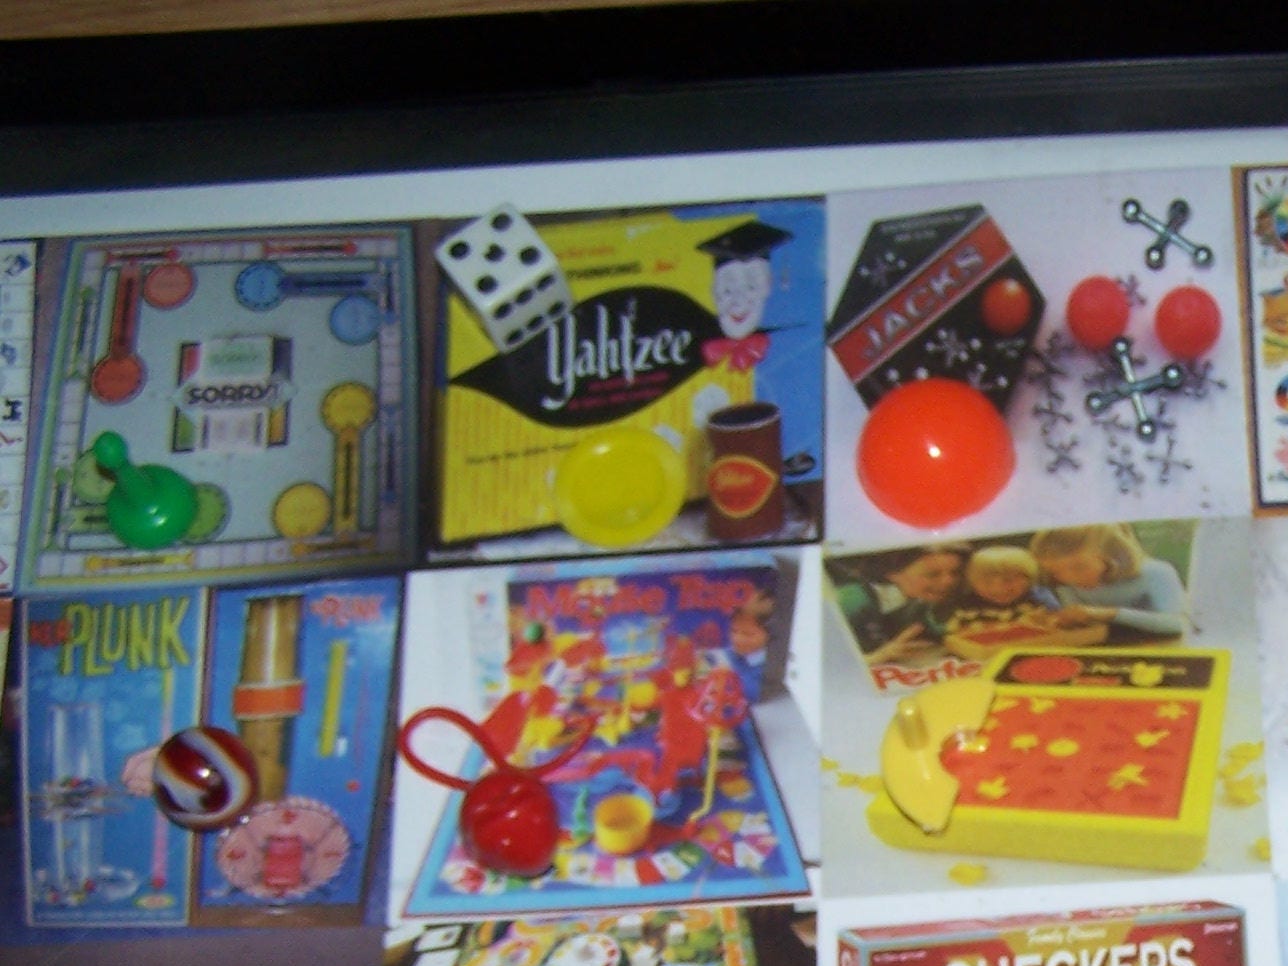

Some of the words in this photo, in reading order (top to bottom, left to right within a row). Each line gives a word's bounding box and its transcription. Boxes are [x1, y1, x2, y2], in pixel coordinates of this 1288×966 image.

[541, 296, 692, 410] Yahtzee
[865, 245, 986, 361] JACKS
[60, 596, 191, 677] PLUNK
